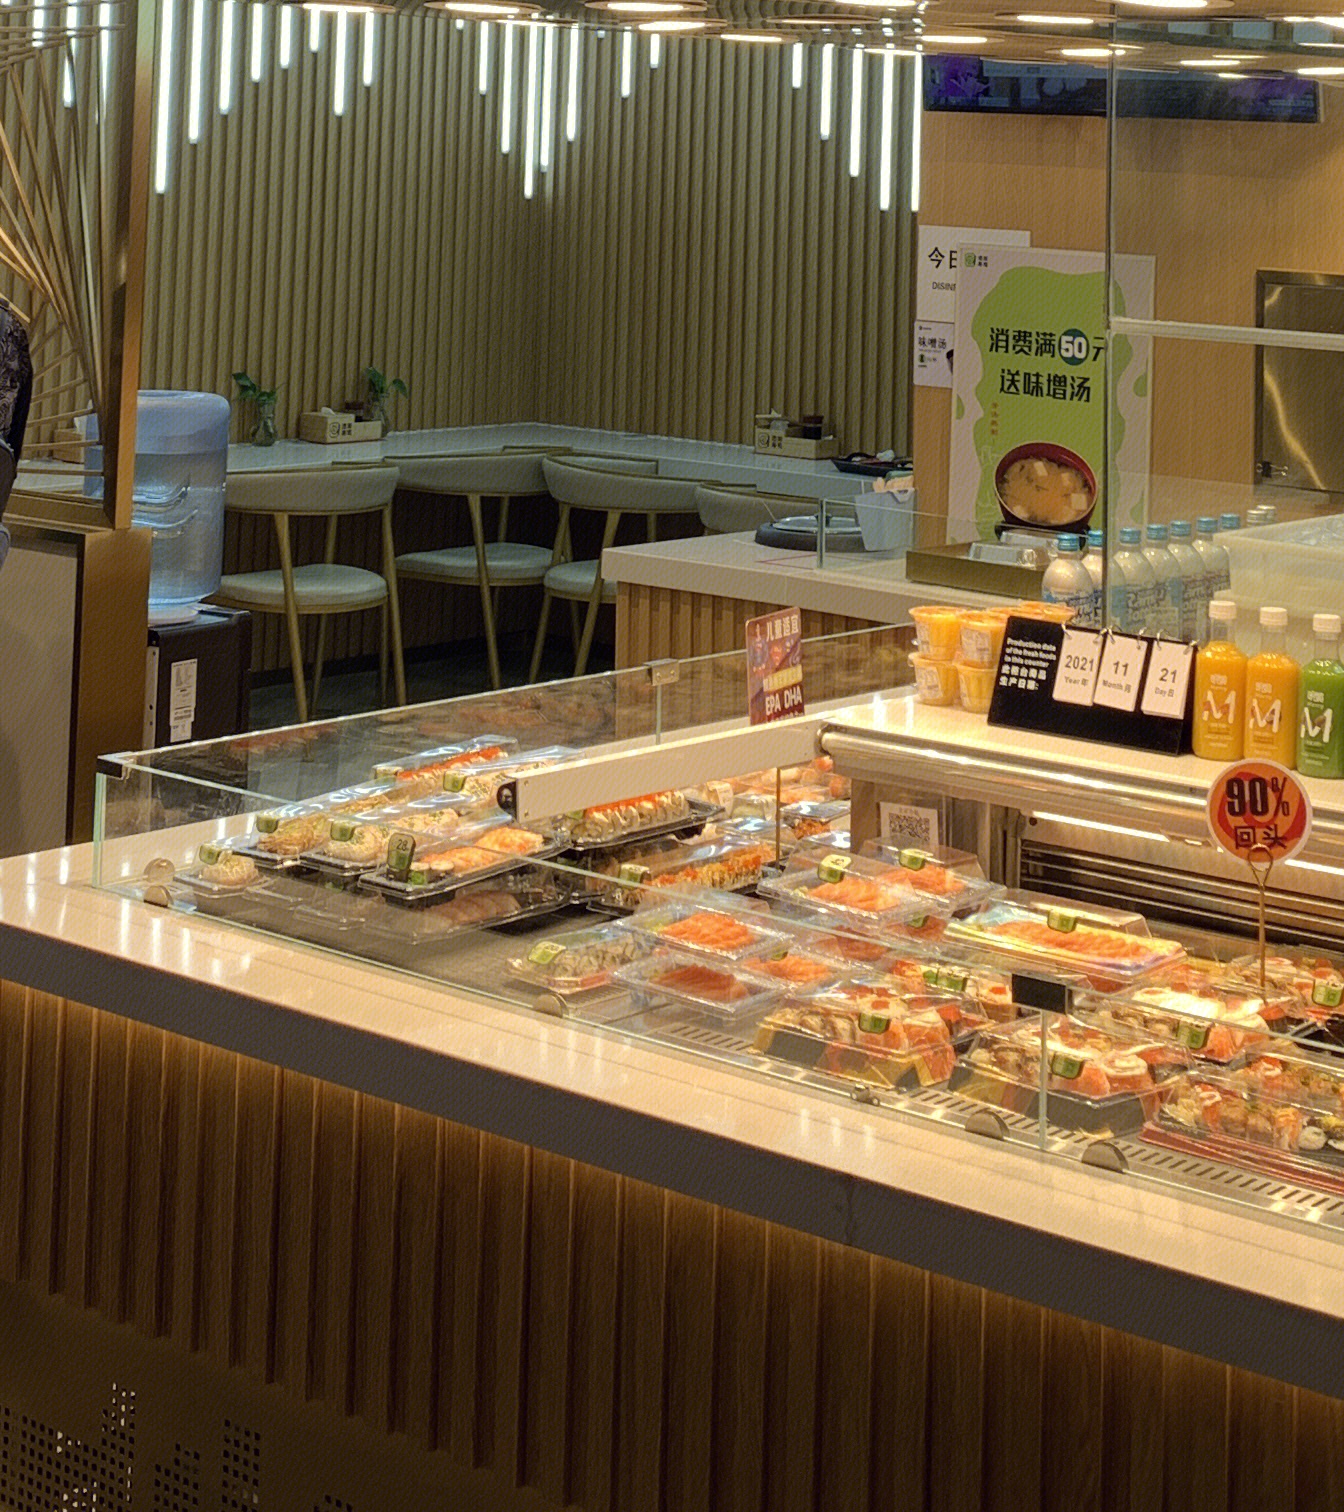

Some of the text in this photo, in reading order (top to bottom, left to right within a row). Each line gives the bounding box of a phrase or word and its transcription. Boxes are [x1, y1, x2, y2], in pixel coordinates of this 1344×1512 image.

[999, 368, 1091, 403] 送味增汤
[1065, 654, 1095, 672] 2021
[1113, 660, 1130, 677] 11
[1064, 676, 1080, 684] Year
[1159, 667, 1178, 684] 21
[1102, 679, 1123, 691] Month
[1154, 687, 1167, 697] Day
[765, 685, 803, 716] EPA DHA
[1226, 776, 1290, 820] 90%
[396, 839, 408, 851] 28
[1234, 824, 1288, 850] 回头
